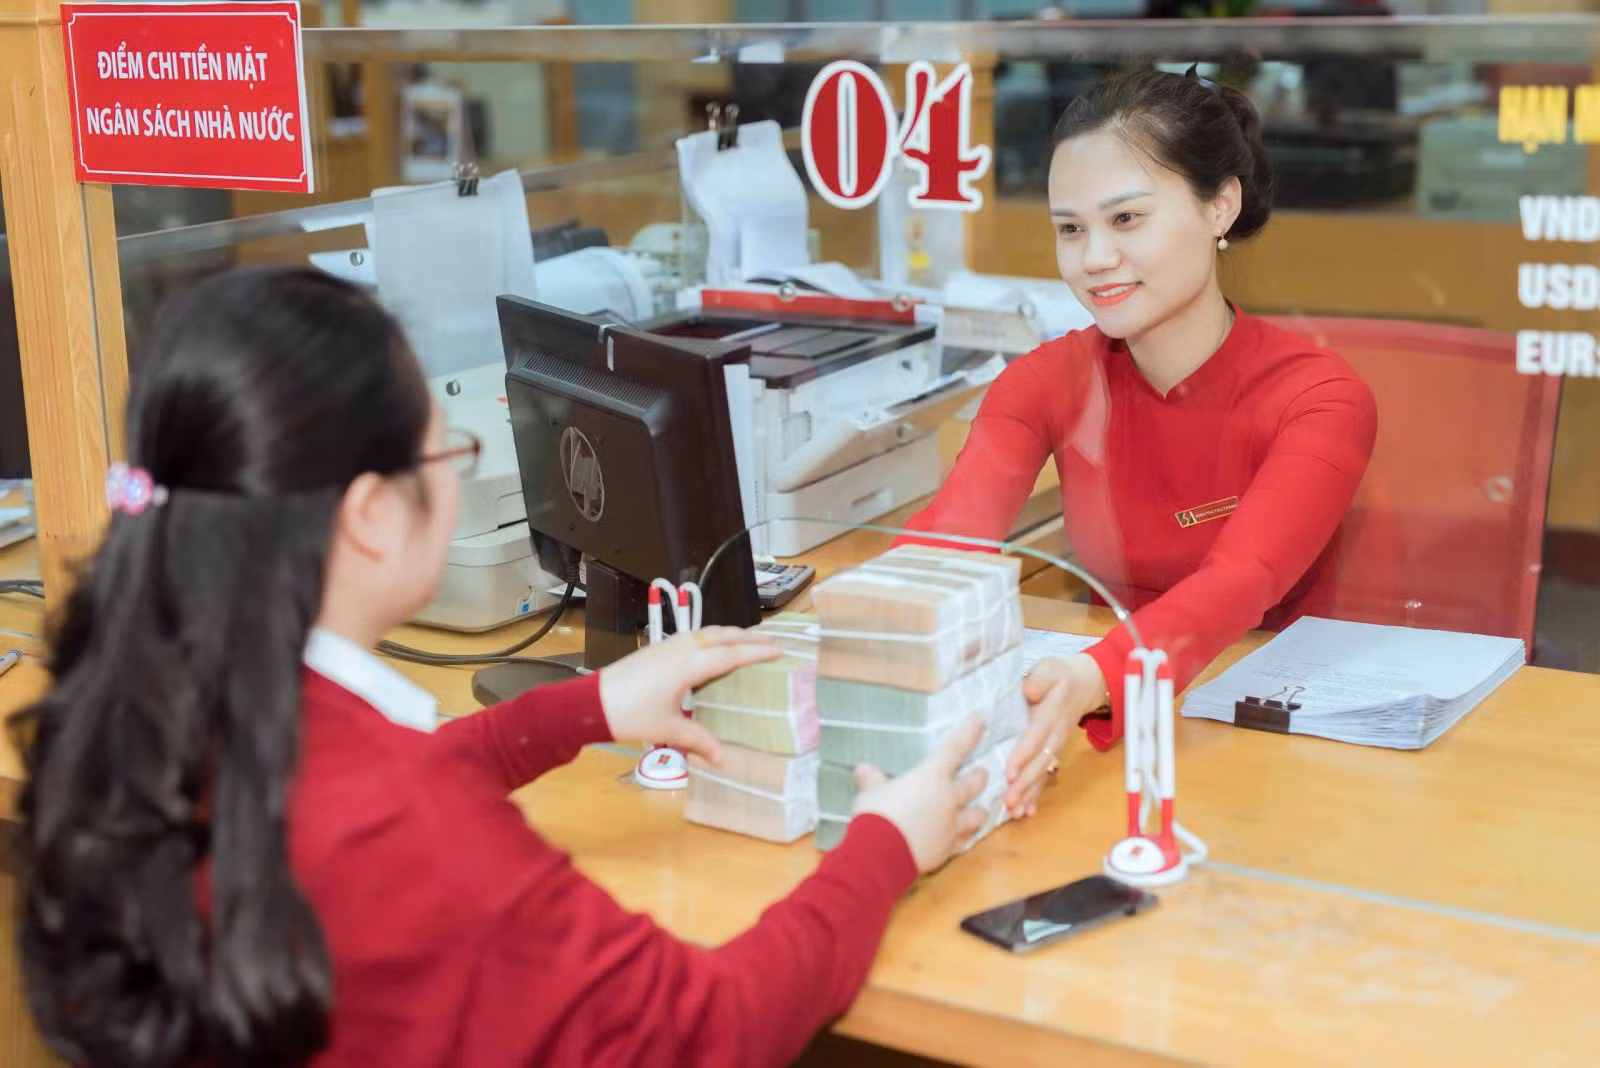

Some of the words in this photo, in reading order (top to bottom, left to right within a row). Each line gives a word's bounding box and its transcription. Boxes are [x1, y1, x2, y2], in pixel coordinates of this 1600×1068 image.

[97, 40, 145, 79] ĐIỂM
[147, 51, 179, 80] CHI
[180, 43, 223, 81] TIỀN
[226, 45, 268, 90] MẶT
[86, 101, 140, 136] NGÂN
[142, 102, 191, 138] SÁCH
[194, 104, 237, 139] NHÀ
[239, 105, 296, 142] NƯỚC
[802, 60, 992, 211] 04
